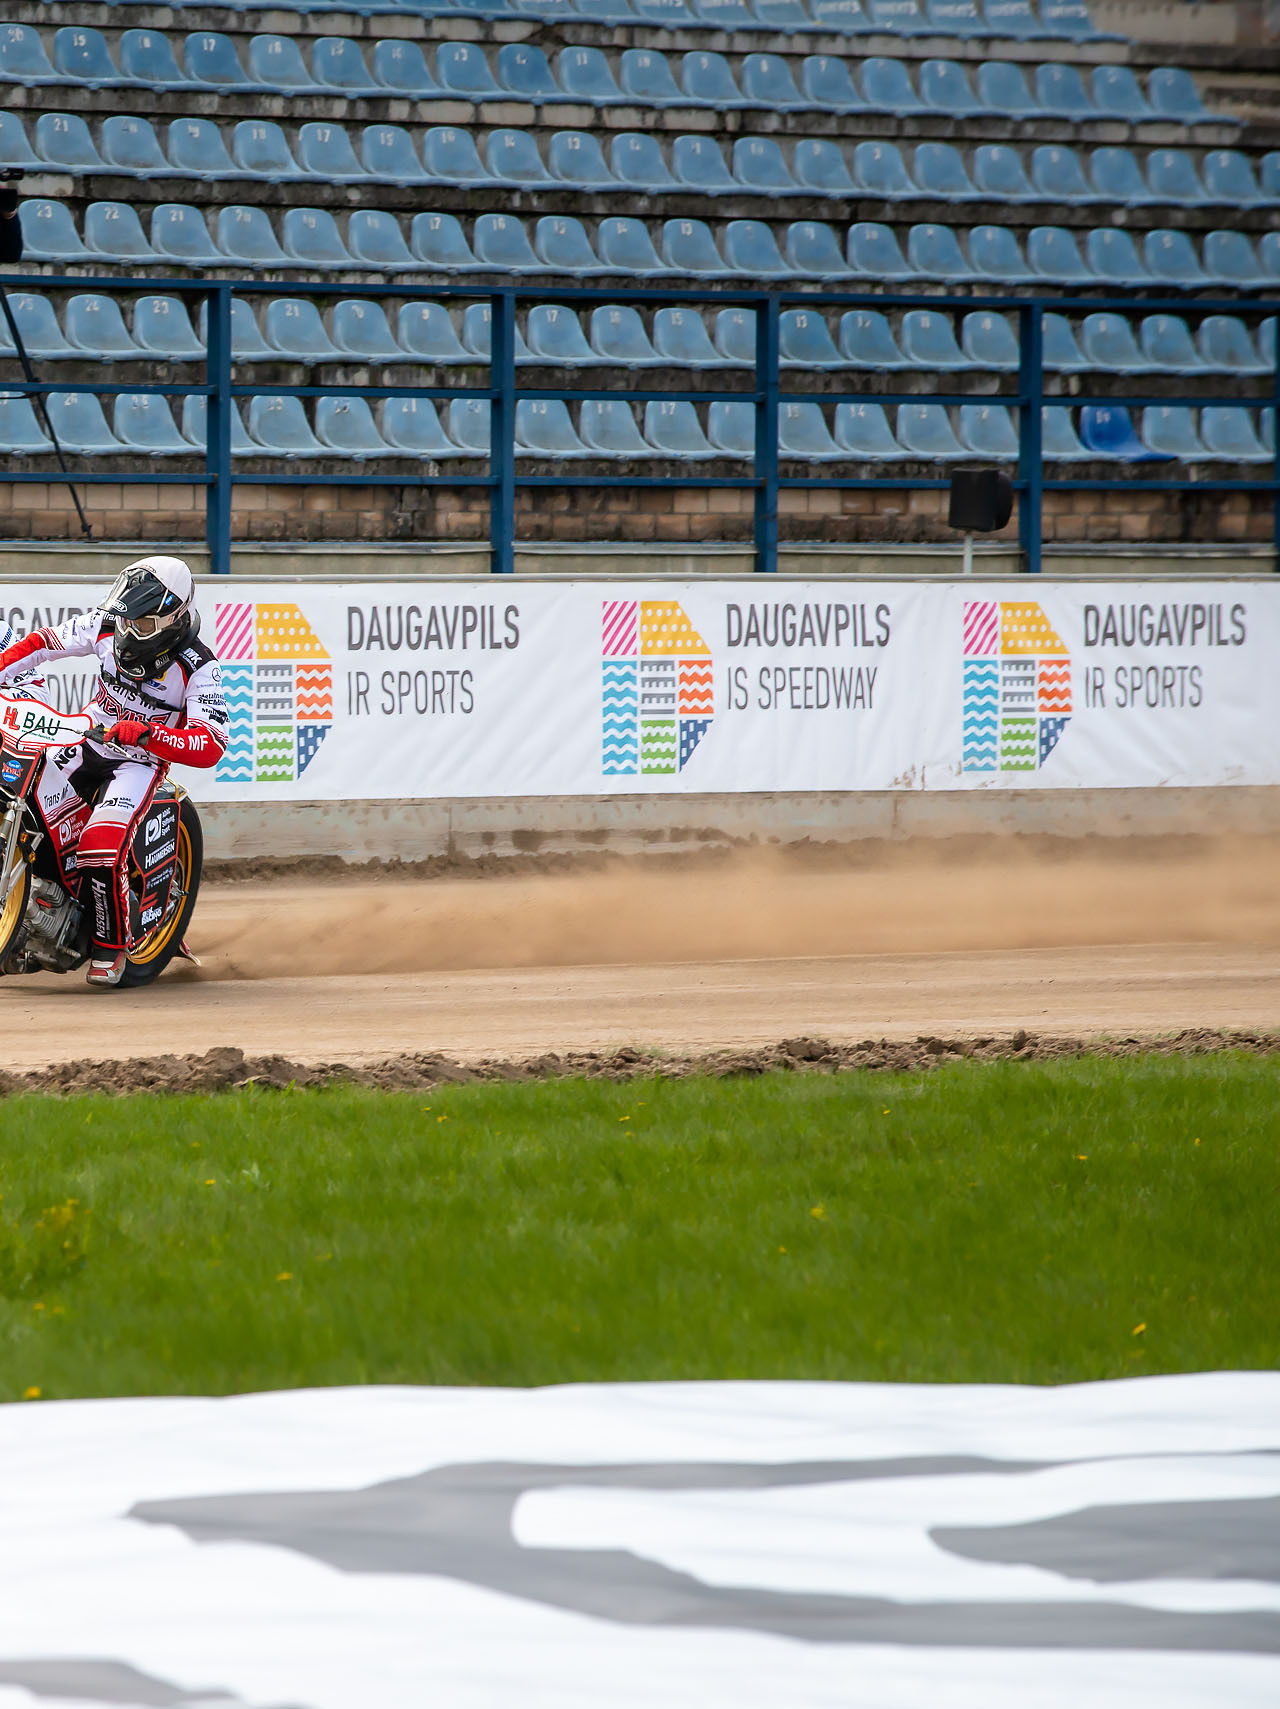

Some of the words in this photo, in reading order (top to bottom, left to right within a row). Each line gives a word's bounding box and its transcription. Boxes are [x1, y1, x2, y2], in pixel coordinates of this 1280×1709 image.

[203, 38, 216, 52] 17
[54, 117, 69, 132] 21
[317, 129, 331, 143] 17
[104, 207, 120, 220] 22
[170, 209, 184, 222] 21
[285, 303, 300, 317] 21
[546, 309, 558, 323] 17
[104, 611, 117, 622] Tra
[726, 603, 891, 647] DAUGAVPILS
[1084, 603, 1247, 647] DAUGAVPILS
[347, 605, 520, 651] DAUGAVPILS
[348, 671, 370, 715] IR
[381, 669, 474, 715] SPORTS
[728, 666, 748, 710] IS
[758, 666, 878, 710] SPEEDWAY
[1085, 666, 1106, 709] IR
[1115, 665, 1203, 709] SPORTS
[23, 711, 61, 737] BAU
[152, 725, 185, 749] Trans
[188, 735, 209, 751] MF
[44, 792, 60, 811] Trans
